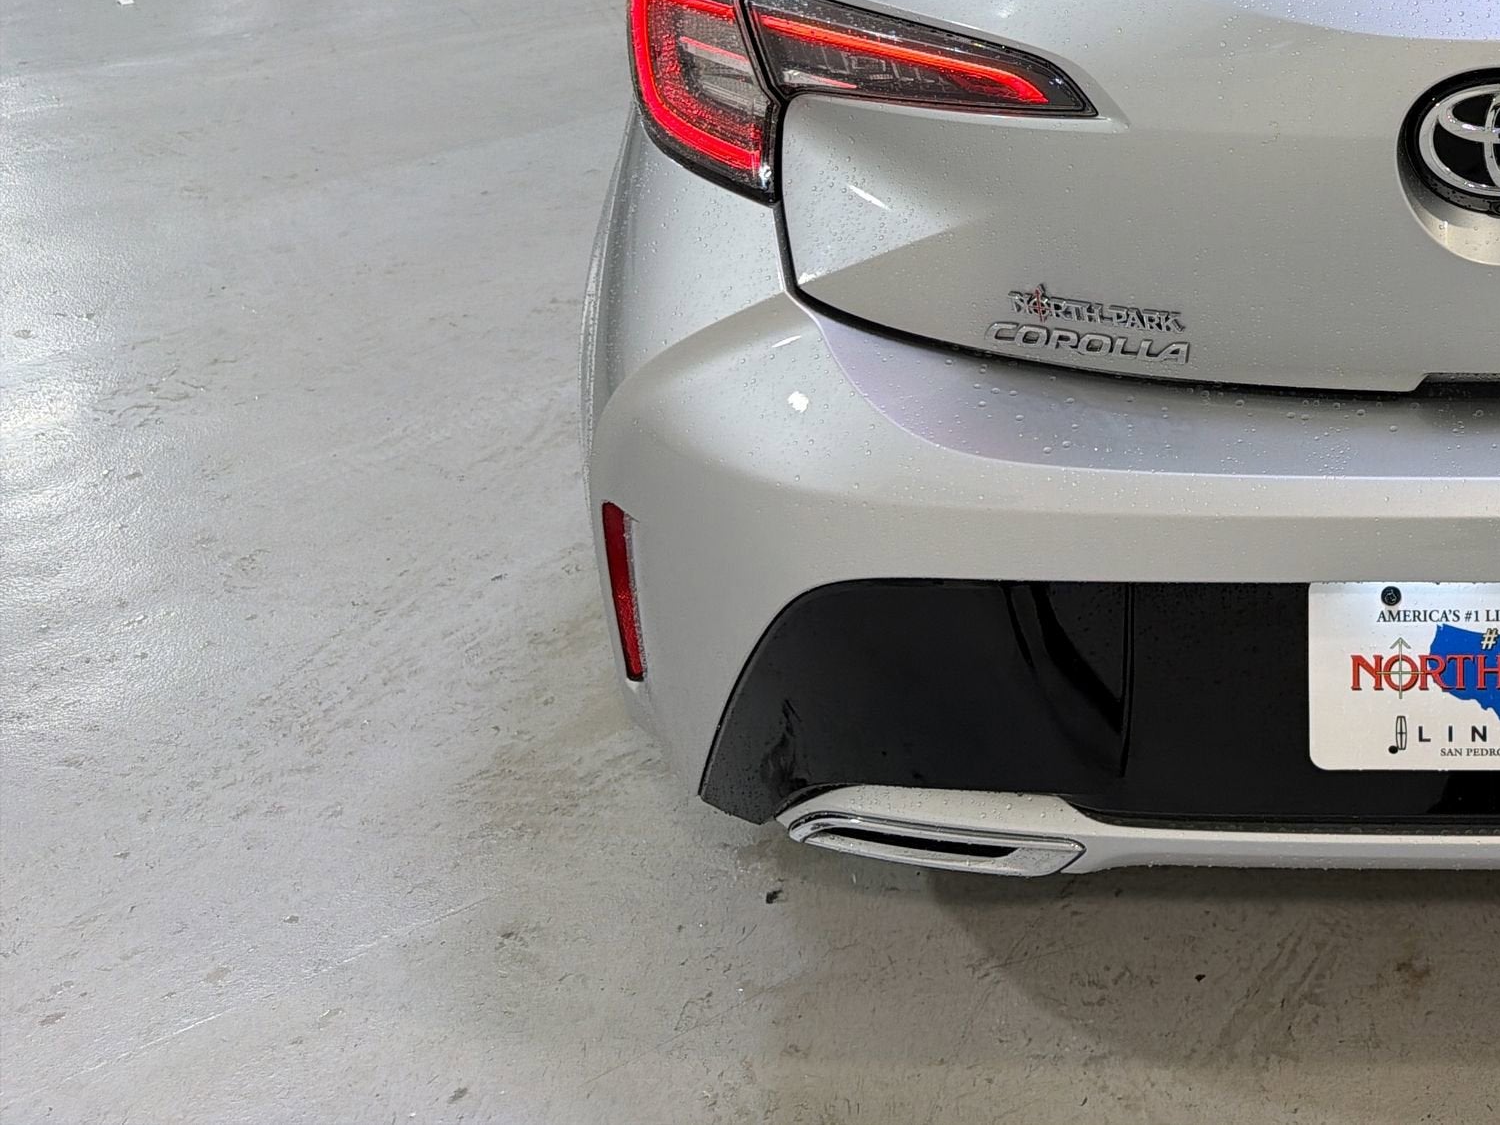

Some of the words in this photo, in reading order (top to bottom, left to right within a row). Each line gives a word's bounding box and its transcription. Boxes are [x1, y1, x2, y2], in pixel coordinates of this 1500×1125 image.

[1108, 305, 1186, 334] PARK
[985, 321, 1191, 364] COROLLA
[1376, 609, 1461, 623] AMERICA'S
[1464, 609, 1480, 622] #1
[1440, 747, 1463, 757] SAN
